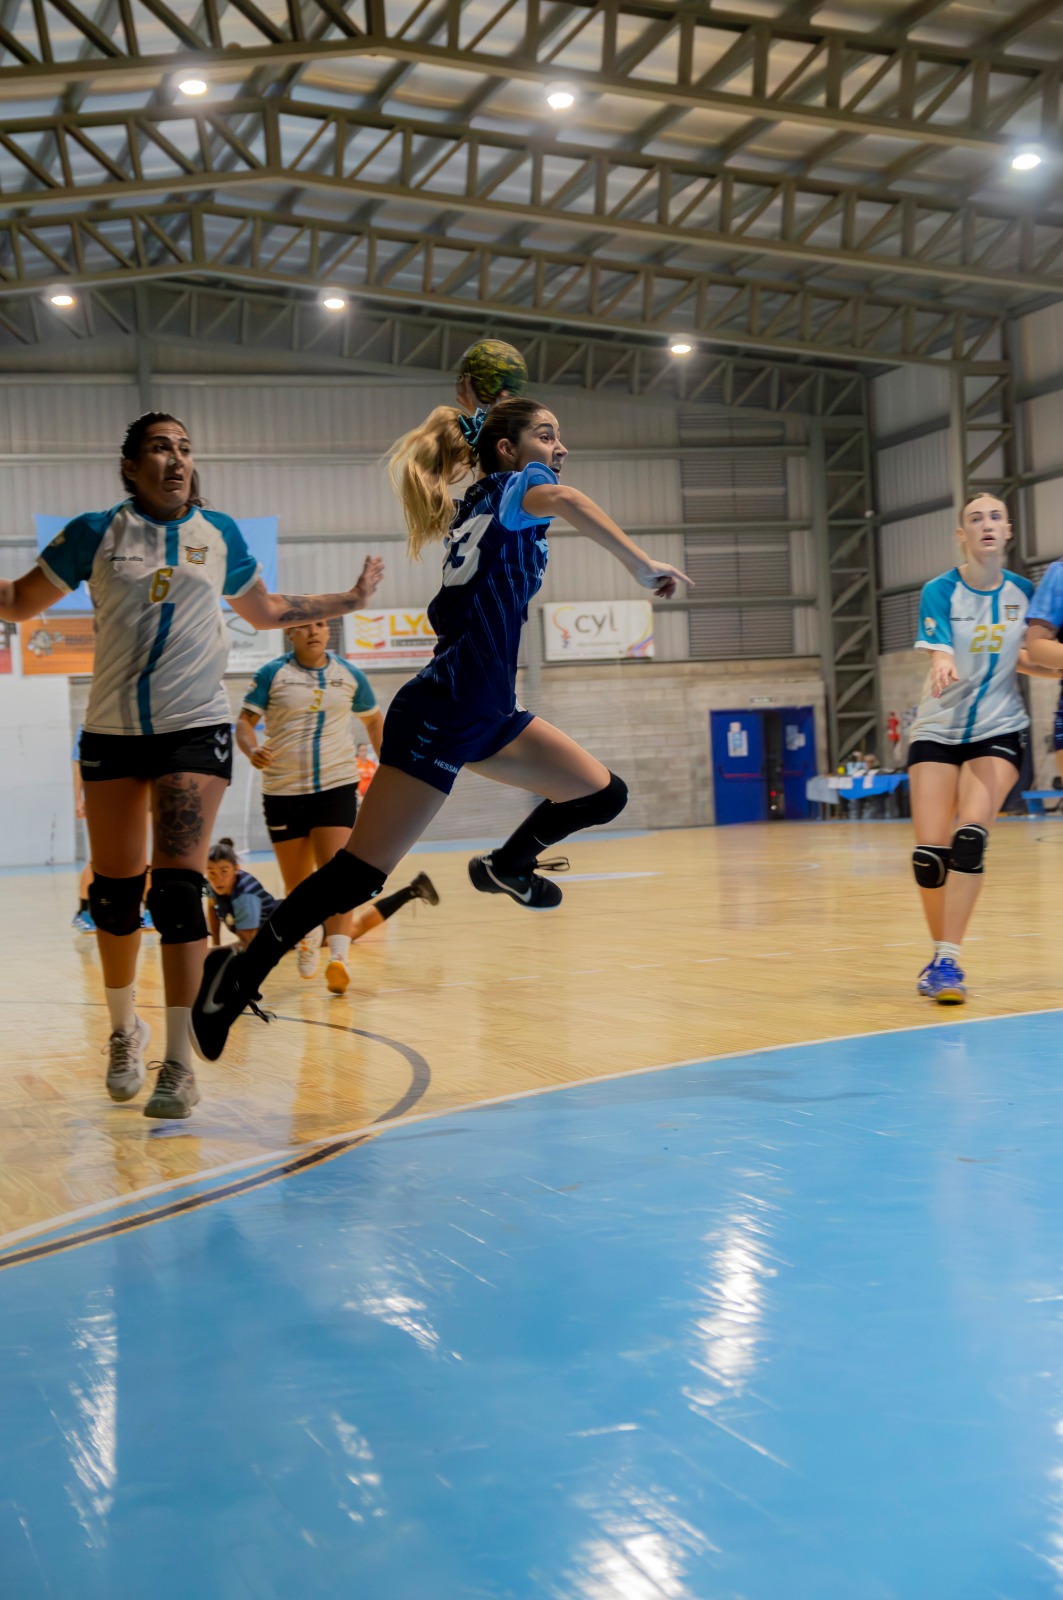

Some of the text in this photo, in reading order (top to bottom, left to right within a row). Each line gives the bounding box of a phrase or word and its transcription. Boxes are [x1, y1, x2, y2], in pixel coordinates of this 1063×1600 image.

[150, 567, 173, 603] 6
[575, 605, 619, 639] cyl
[969, 623, 1006, 653] 25
